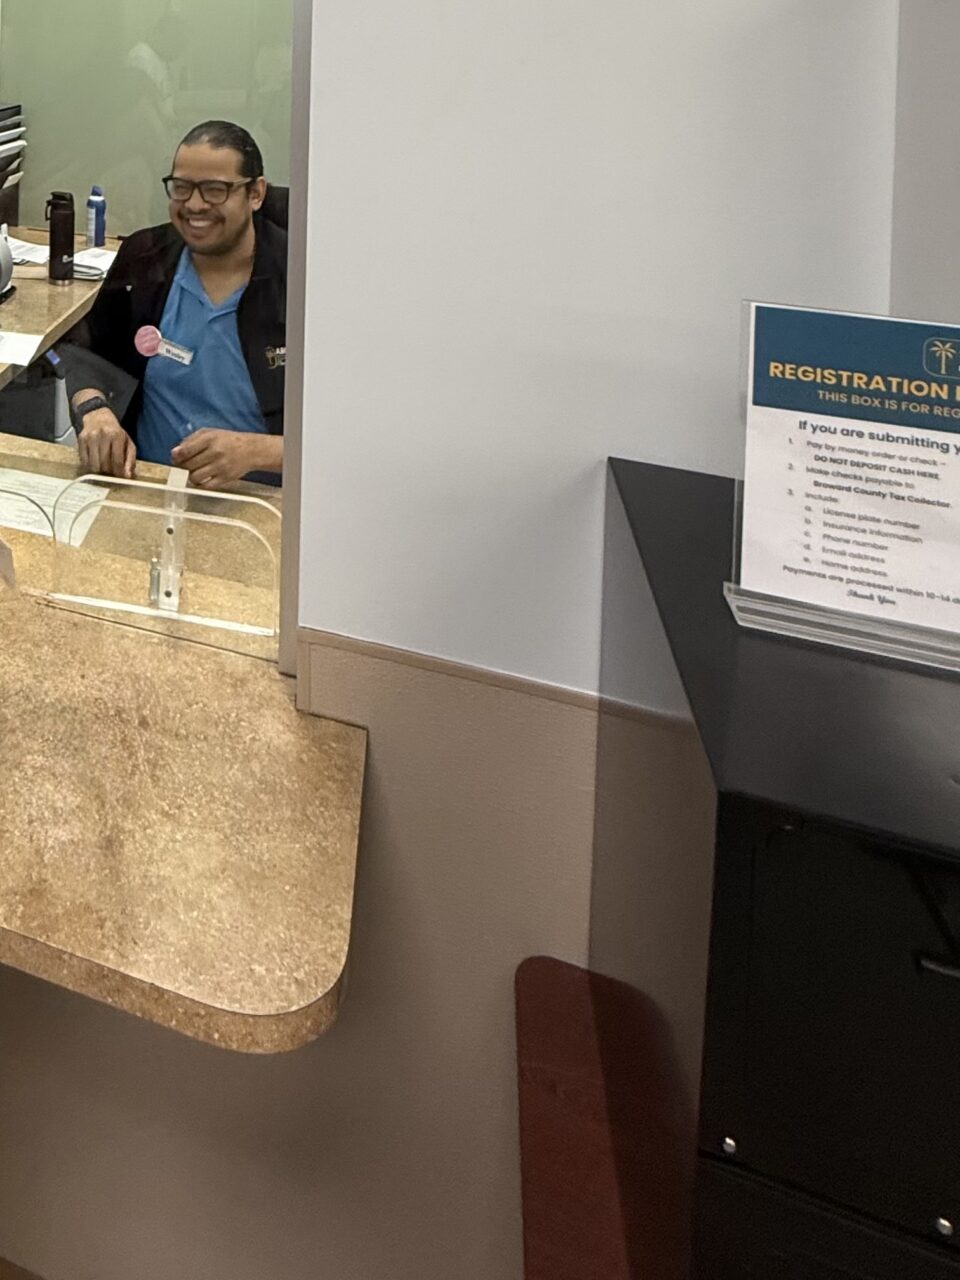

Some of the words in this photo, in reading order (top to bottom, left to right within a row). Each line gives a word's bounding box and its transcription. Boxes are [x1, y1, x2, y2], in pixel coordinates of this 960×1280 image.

[768, 361, 949, 399] REGISTRATION
[818, 390, 848, 403] THIS
[851, 393, 881, 408] BOX
[885, 398, 898, 410] IS
[901, 401, 930, 414] FOR
[933, 406, 960, 418] REG
[798, 419, 808, 430] If
[810, 423, 837, 435] you
[840, 427, 865, 438] are
[868, 432, 950, 453] submitting
[806, 440, 823, 450] Pay
[824, 443, 836, 452] by
[838, 446, 869, 457] money
[871, 451, 896, 459] order
[909, 456, 938, 466] check
[813, 454, 828, 462] DO
[829, 457, 848, 465] NOT
[850, 459, 887, 471] DEPOSIT
[888, 466, 916, 476] CASH
[806, 466, 830, 476] Make
[831, 470, 863, 481] checks
[865, 476, 903, 487] payable
[813, 480, 852, 492] Broward
[853, 486, 887, 499] County
[889, 492, 906, 501] Tax
[823, 507, 856, 519] License
[857, 514, 881, 523] plate
[883, 518, 920, 529] number
[823, 521, 867, 534] Insurance
[823, 533, 851, 544] Phone
[852, 540, 888, 550] number
[782, 564, 827, 579] Payments
[828, 574, 844, 582] are
[845, 578, 894, 592] processed
[895, 586, 925, 597] within
